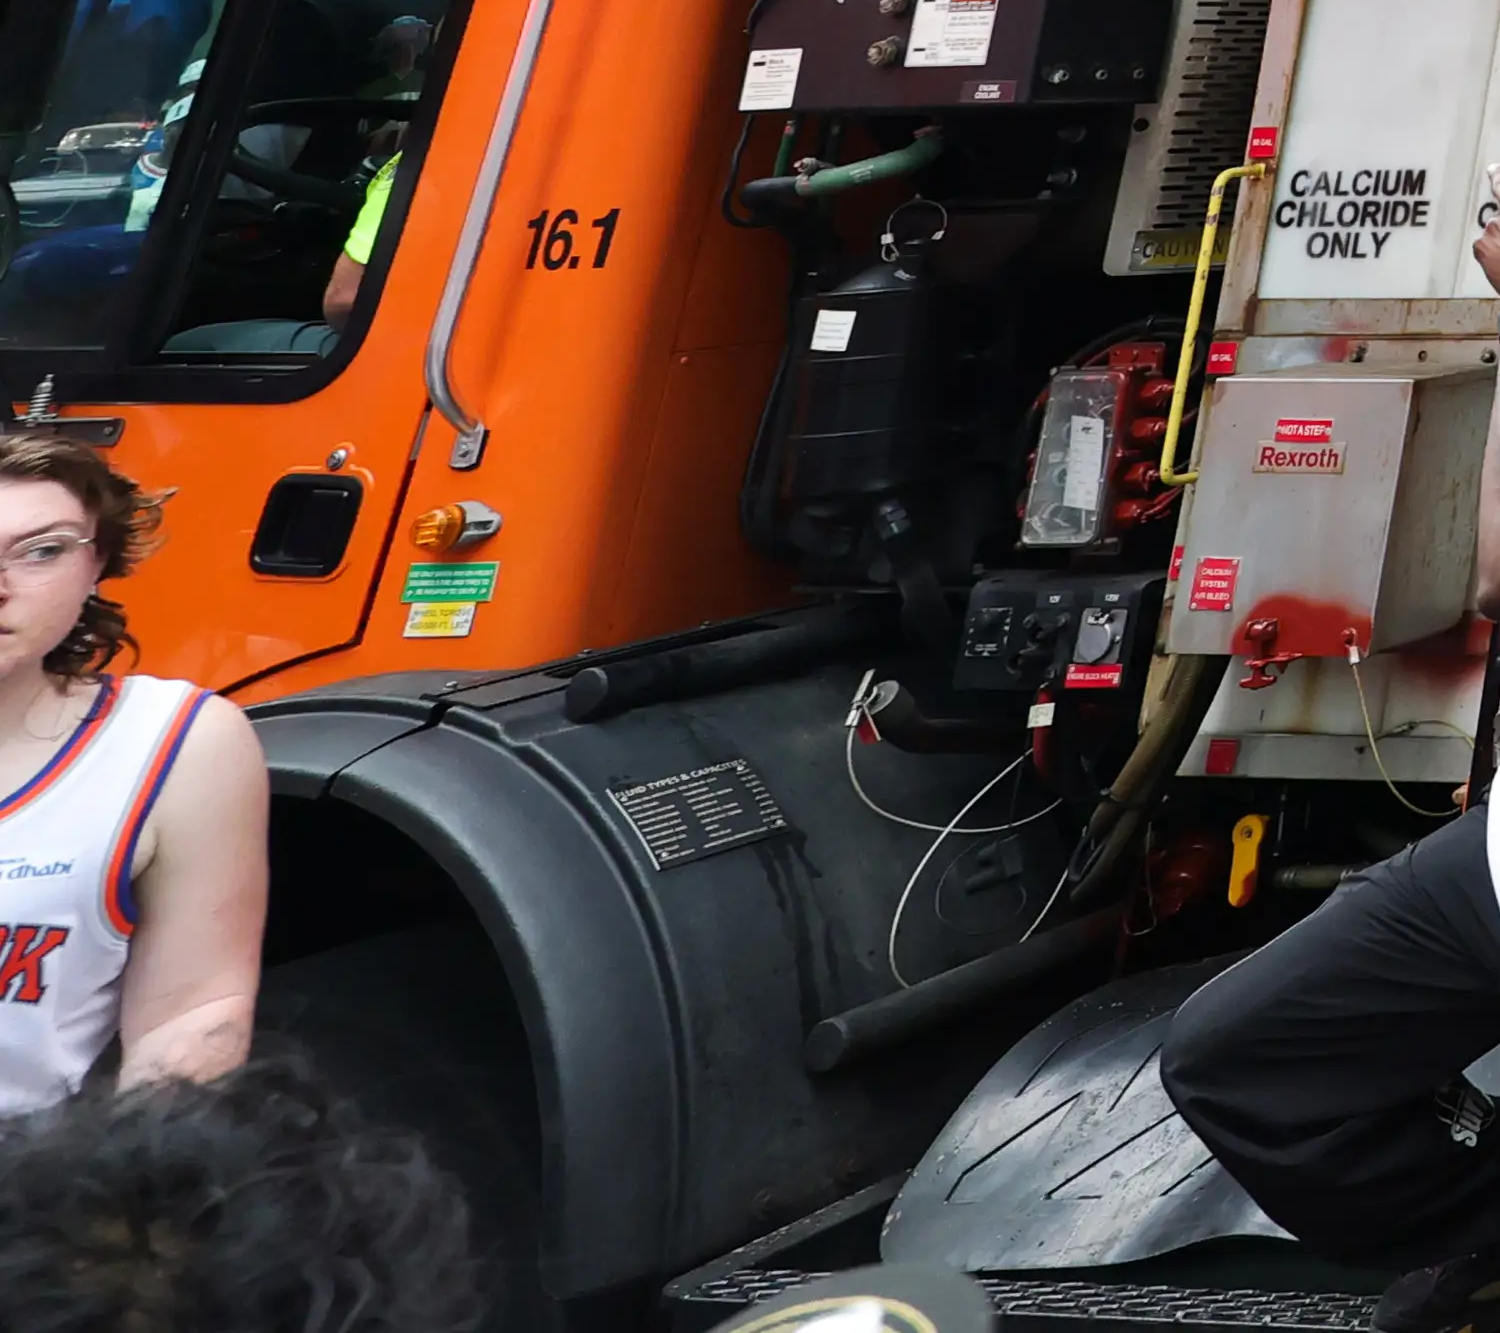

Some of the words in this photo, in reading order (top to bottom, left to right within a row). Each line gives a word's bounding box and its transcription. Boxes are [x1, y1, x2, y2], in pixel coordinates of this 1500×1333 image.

[1290, 169, 1427, 197] CALCIUM
[1275, 200, 1430, 228] CHLORIDE
[525, 208, 621, 270] 16.1
[1306, 232, 1392, 259] ONLY
[1281, 425, 1297, 435] NOT
[1296, 425, 1303, 435] A
[1259, 447, 1340, 468] Rexroth
[1201, 567, 1233, 576] CALCIUM
[1200, 579, 1228, 588] SYSTEM
[1206, 592, 1230, 600] BLEED
[647, 776, 680, 790] TYPES
[679, 773, 690, 781] &
[690, 758, 747, 778] CAPACITIES
[7, 859, 74, 880] dhabi
